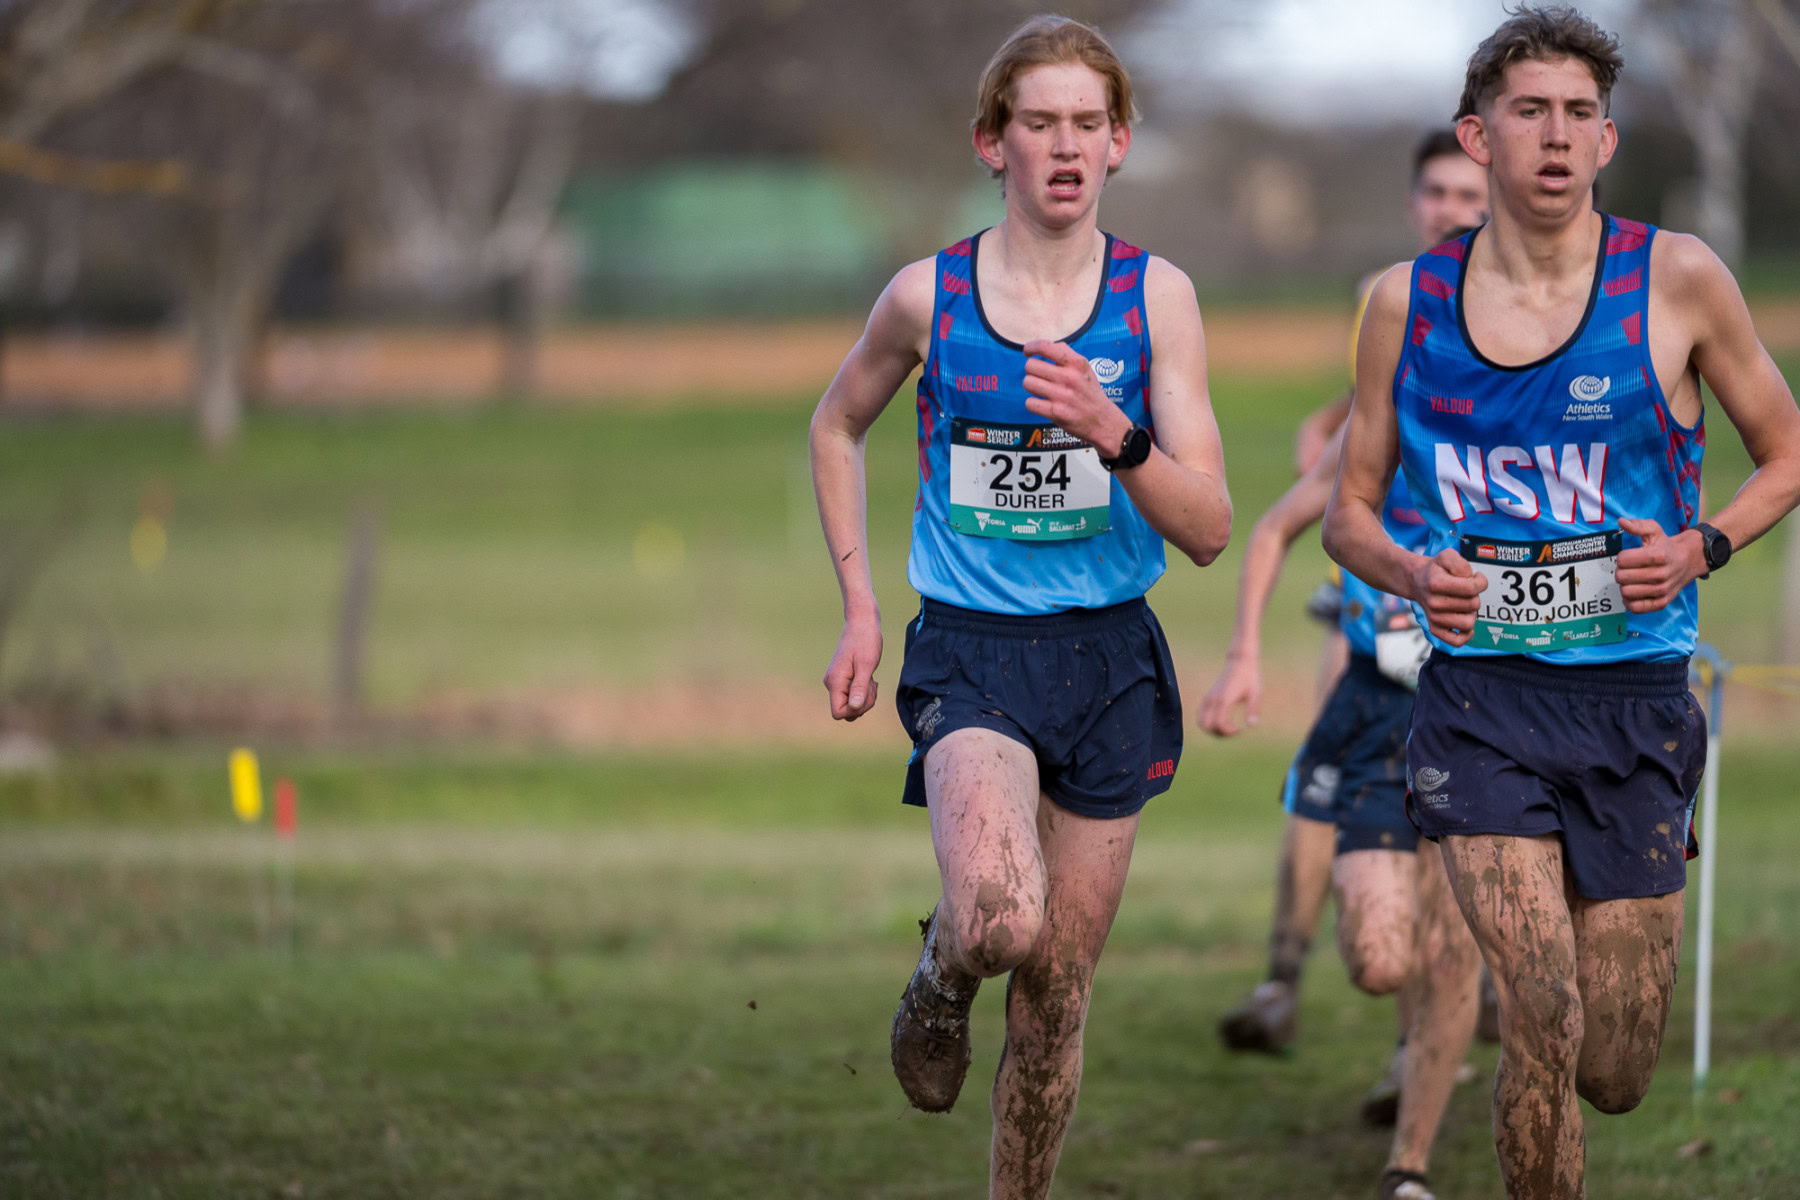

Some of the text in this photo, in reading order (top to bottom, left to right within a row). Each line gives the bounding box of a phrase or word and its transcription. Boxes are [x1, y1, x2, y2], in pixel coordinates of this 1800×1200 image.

[955, 375, 998, 392] VALOUR
[1430, 395, 1473, 415] VALOUR
[1566, 402, 1611, 414] Athletics
[1578, 413, 1594, 421] South
[1596, 412, 1613, 420] Wales
[986, 428, 1020, 438] WINTER
[986, 437, 1014, 446] SERIES
[989, 453, 1071, 492] 254
[1435, 443, 1609, 524] NSW
[995, 493, 1065, 509] DURER
[1496, 545, 1531, 555] WINTER
[1552, 540, 1606, 553] CROSS COUNTRY
[1552, 545, 1607, 559] CHAMPIONSHIPS
[1497, 553, 1524, 562] SERIES
[1501, 566, 1577, 606] 361
